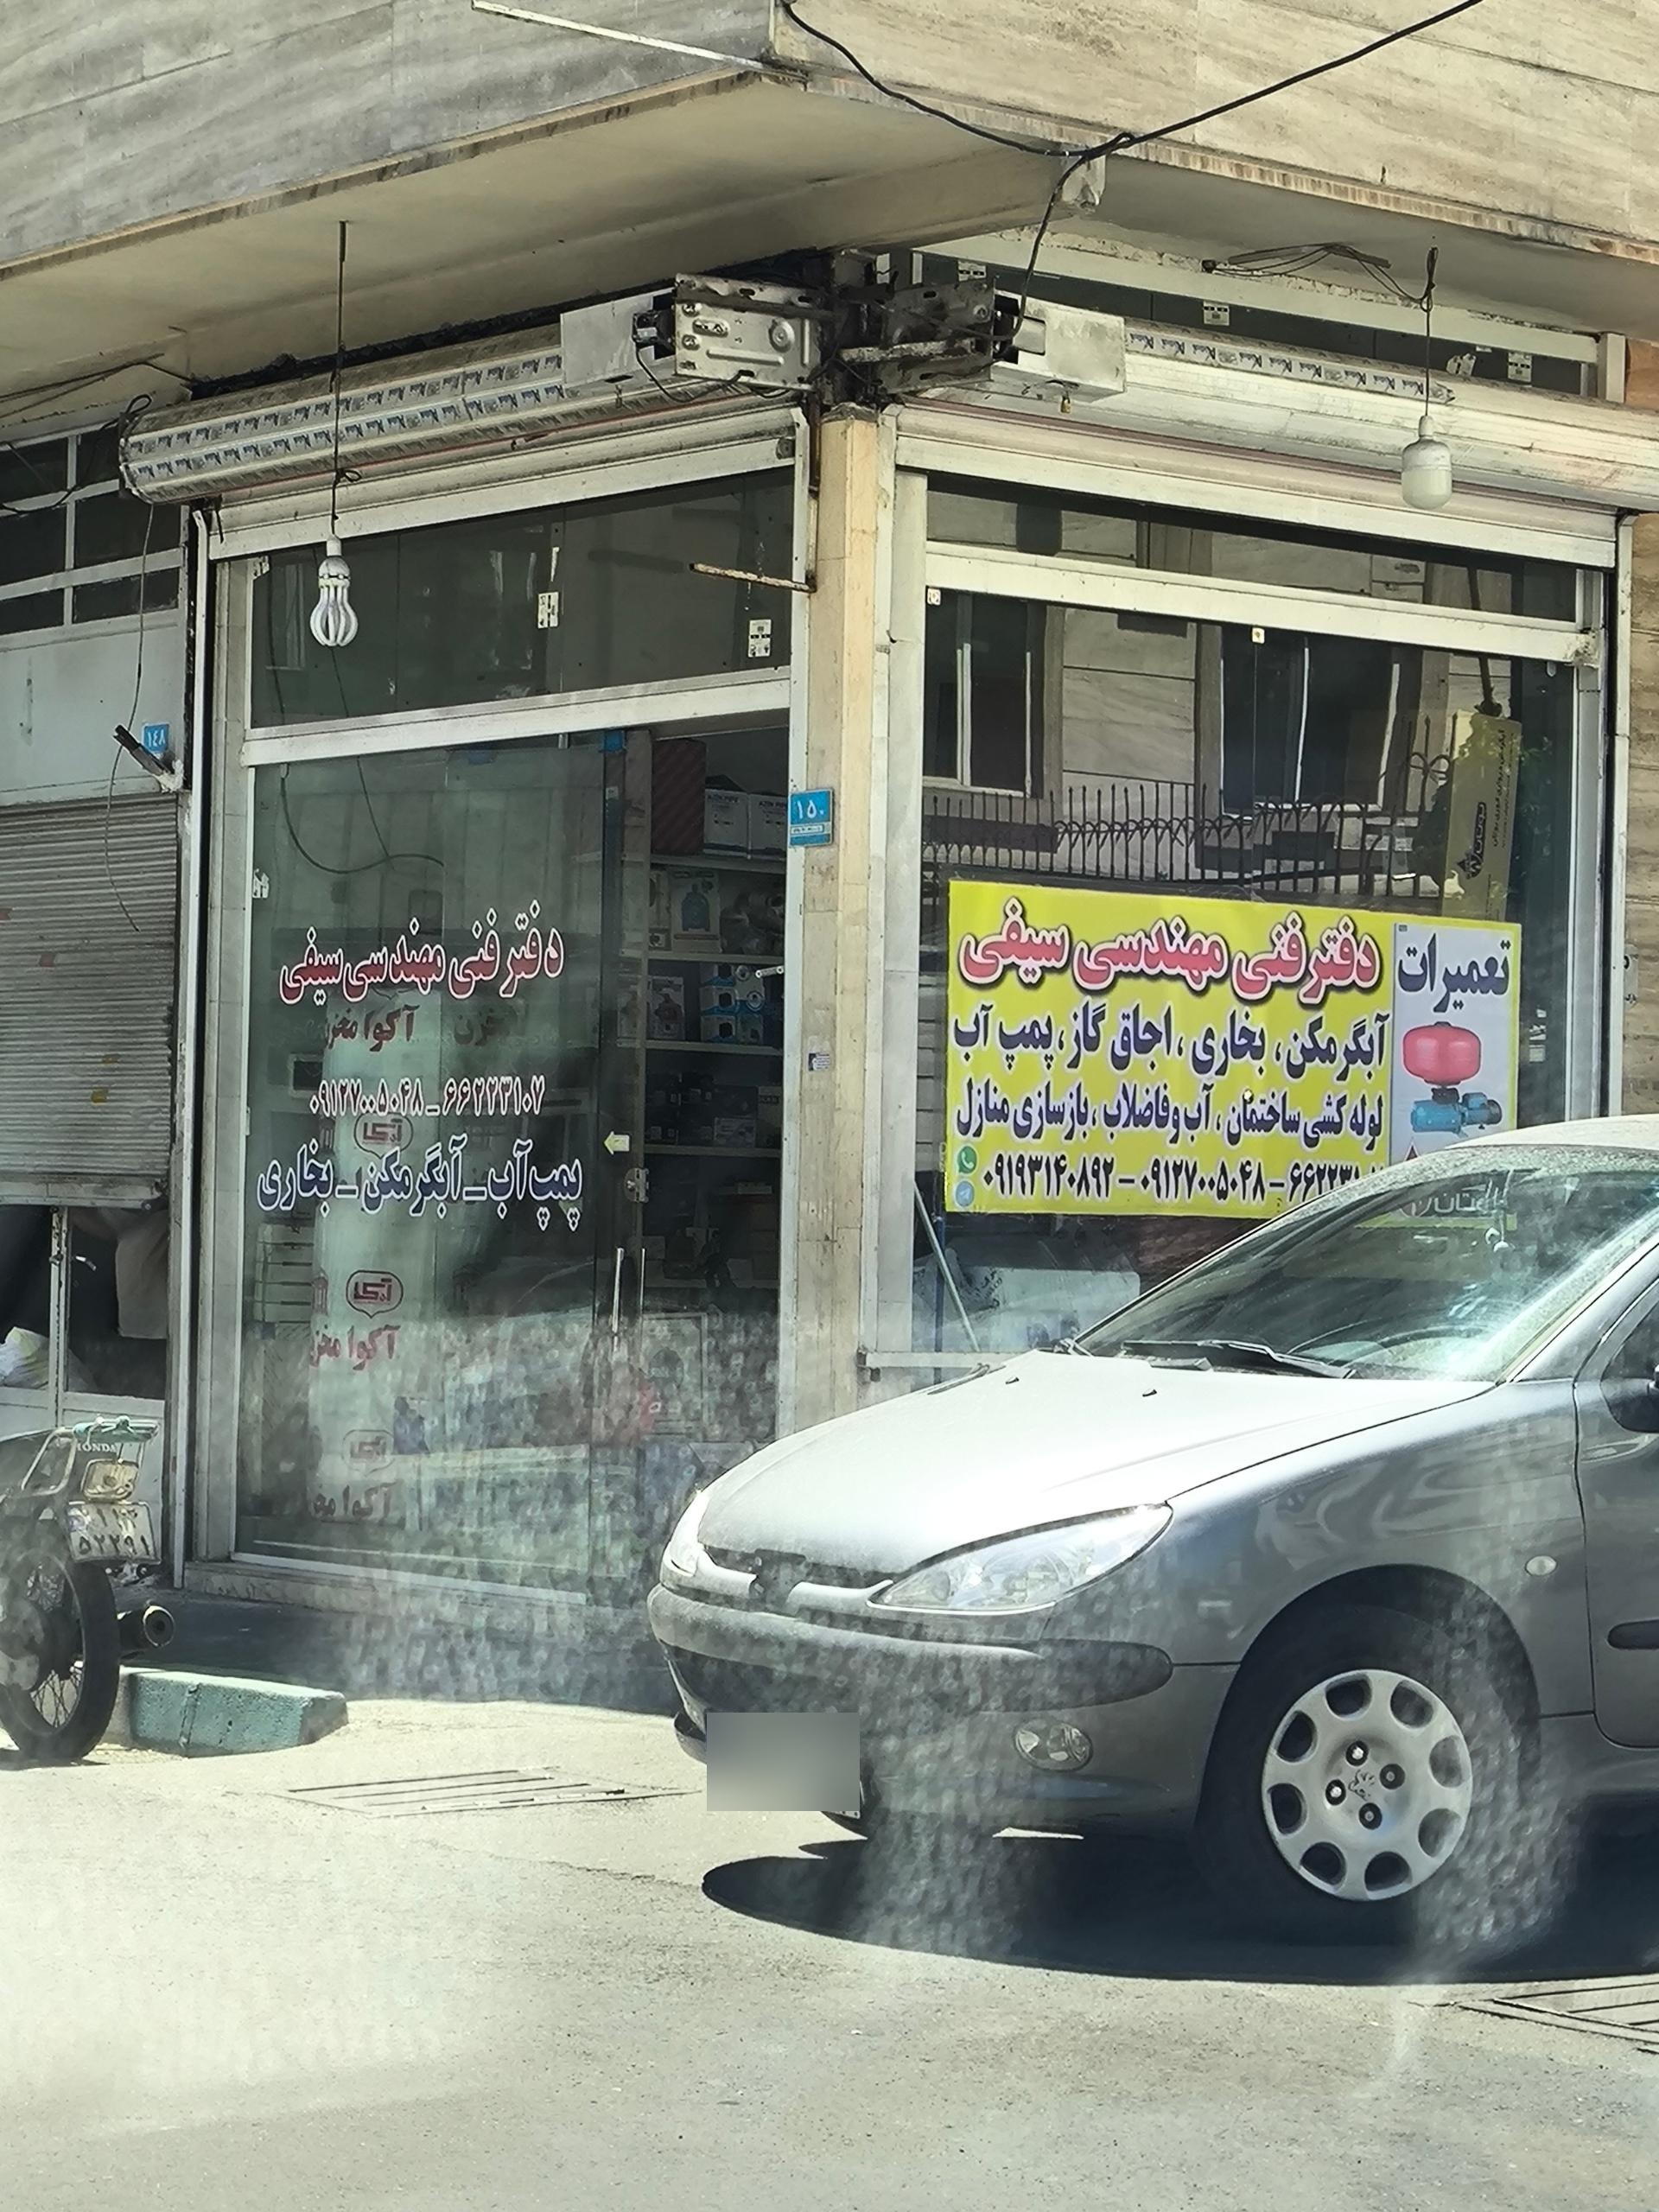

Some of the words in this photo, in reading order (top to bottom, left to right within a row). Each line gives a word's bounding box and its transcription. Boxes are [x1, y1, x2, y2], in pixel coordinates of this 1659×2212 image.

[796, 799, 824, 819] ۱۵۰
[279, 926, 344, 1006] سیفی
[342, 917, 446, 1002] مهندسی
[448, 907, 501, 1000] فنی
[499, 899, 564, 998] دفتر
[961, 899, 1068, 983] سیفی
[1075, 917, 1227, 989] مهندسی
[1233, 912, 1307, 998] فنی
[1300, 914, 1379, 1002] دفتر
[1397, 932, 1510, 1013] تعمیرات
[954, 1004, 993, 1062] آب
[1000, 1014, 1053, 1071] پمپ
[1111, 1003, 1173, 1071] اجاق
[957, 1077, 1009, 1138] منازل
[1013, 1080, 1089, 1141] بازسازی
[1185, 1083, 1215, 1142] آب
[1303, 1094, 1347, 1148] کشی
[1350, 1094, 1384, 1151] لوله
[257, 1138, 334, 1217] بخاری
[487, 1139, 533, 1218] آب
[529, 1159, 582, 1231] پمپ
